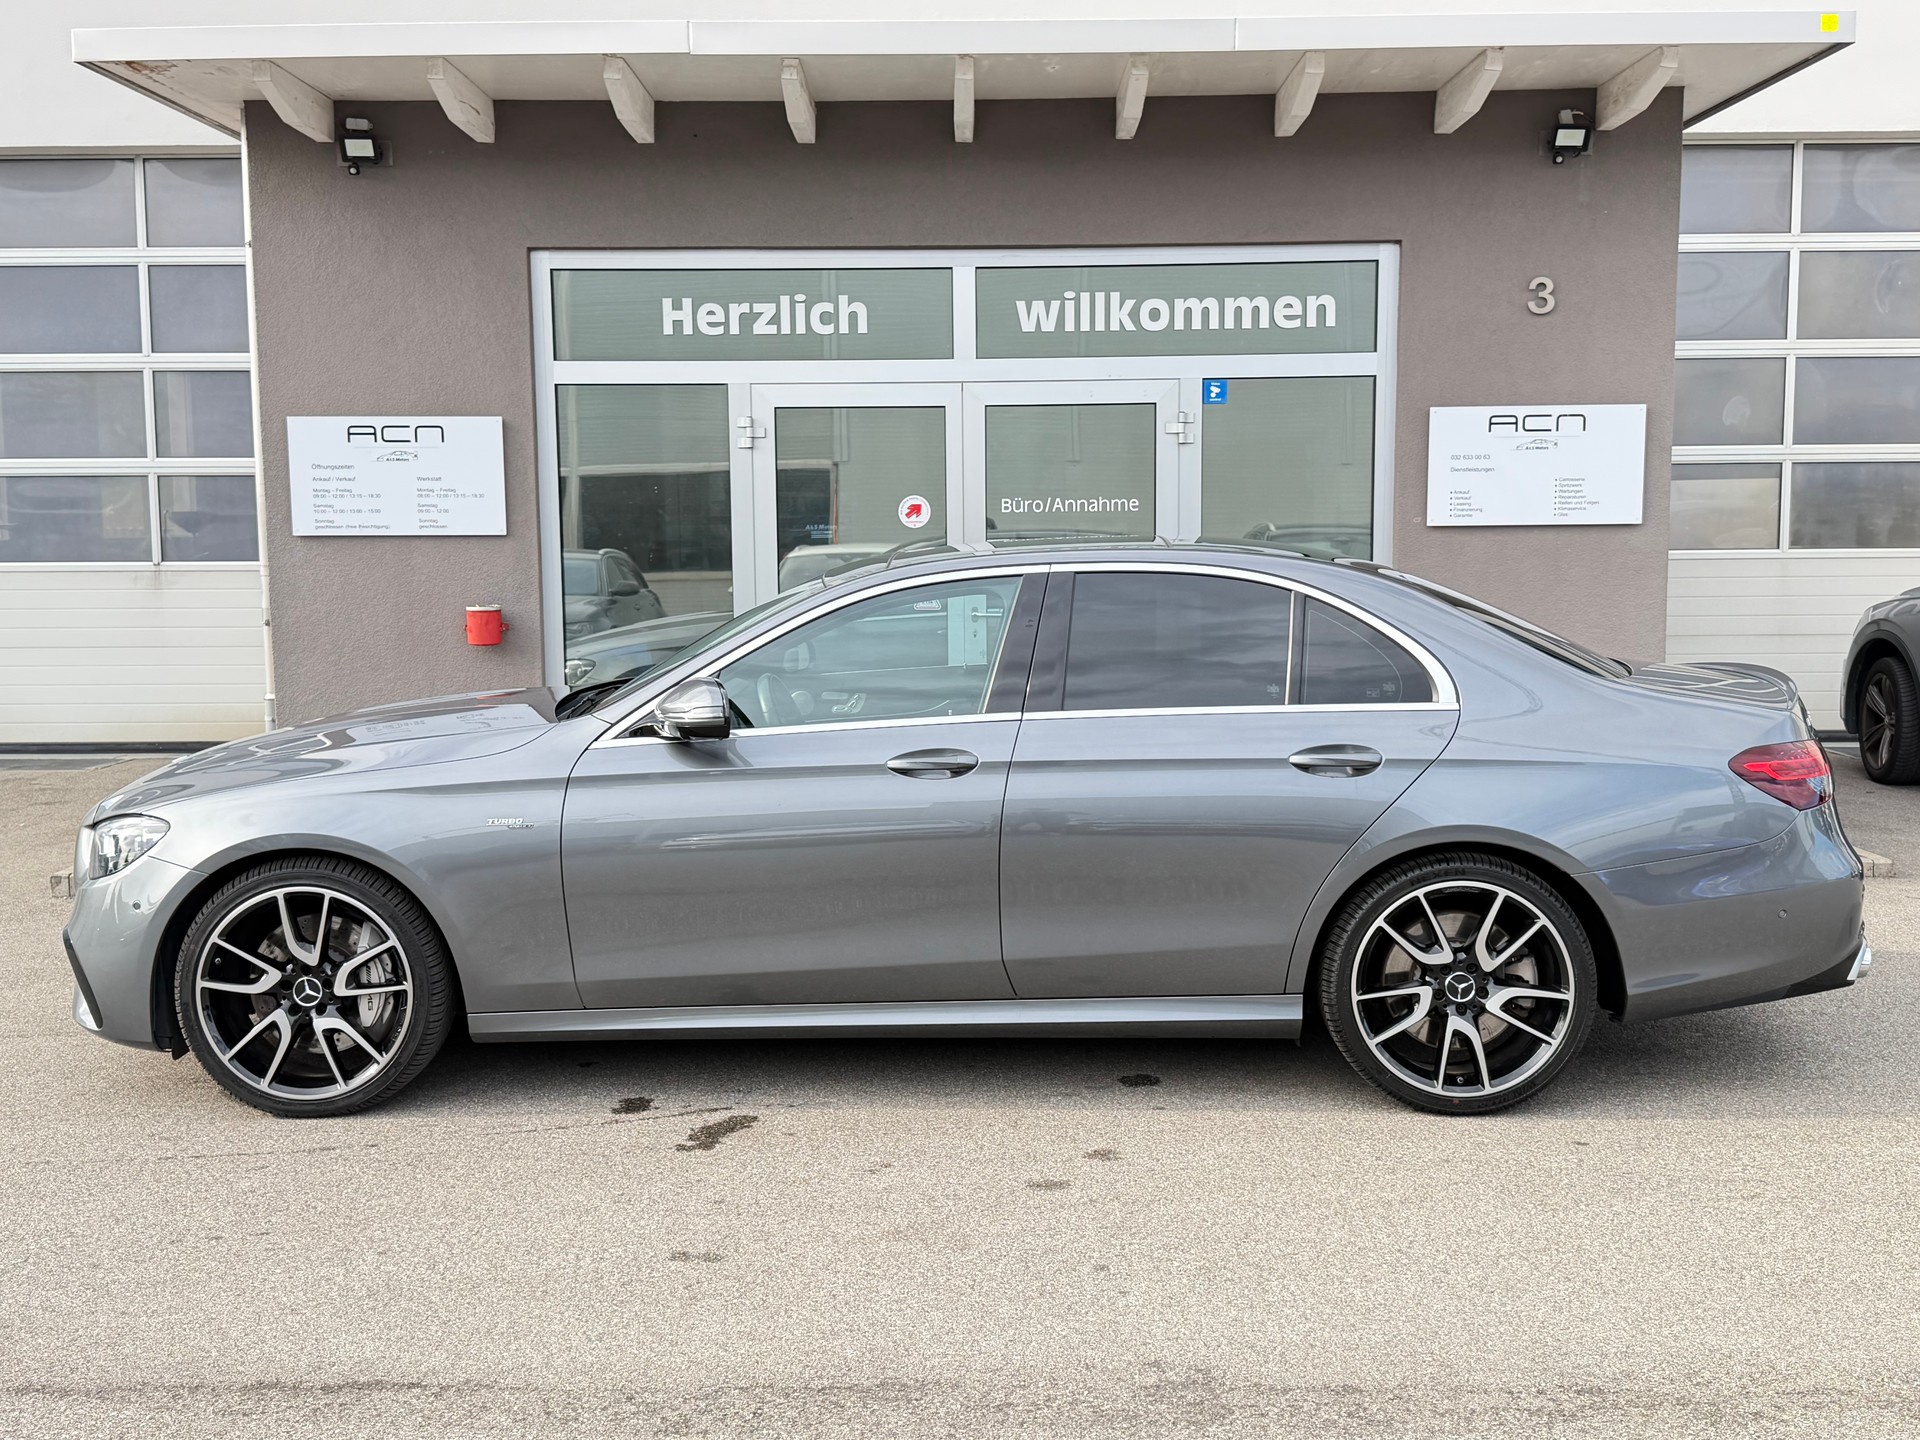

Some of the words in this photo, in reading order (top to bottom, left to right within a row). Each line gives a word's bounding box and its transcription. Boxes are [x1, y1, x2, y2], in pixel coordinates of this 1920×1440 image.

[661, 293, 869, 336] Herzlich
[1015, 290, 1337, 333] willkommen
[1527, 276, 1555, 315] 3
[1001, 496, 1140, 514] Büro/Annahme
